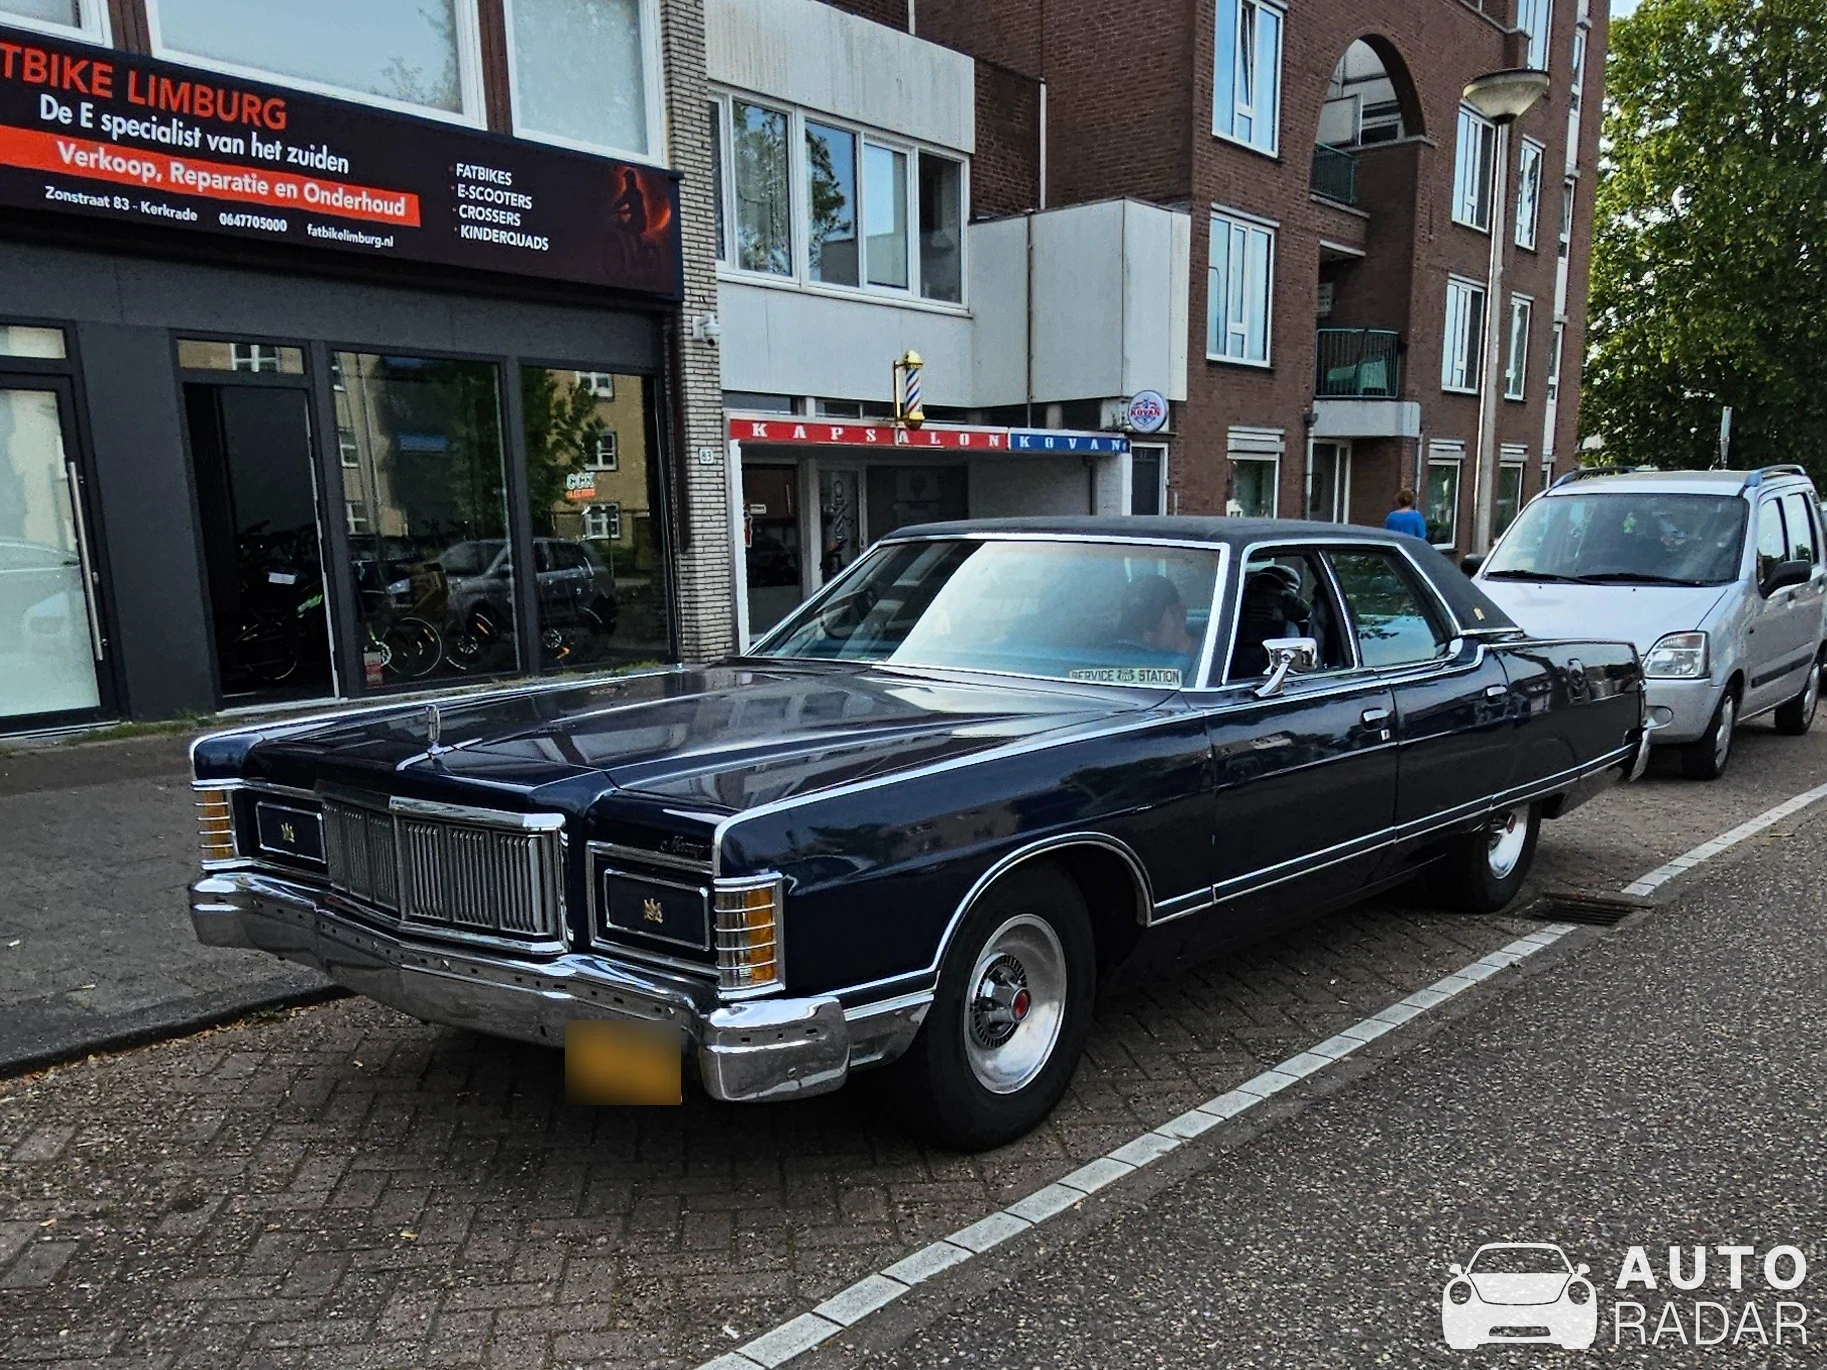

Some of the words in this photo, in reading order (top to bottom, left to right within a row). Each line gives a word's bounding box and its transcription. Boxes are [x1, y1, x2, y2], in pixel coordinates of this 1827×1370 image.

[0, 42, 113, 98] TBIKE
[128, 69, 287, 130] LIMBURG
[40, 93, 73, 123] De
[80, 101, 94, 128] E
[101, 114, 202, 148] specialist
[206, 134, 243, 156] van
[251, 131, 282, 161] het
[287, 143, 349, 174] zuiden
[57, 141, 162, 183] Verkoop,
[170, 161, 268, 196] Reparatie
[275, 180, 298, 199] en
[303, 182, 406, 217] Onderhoud
[456, 162, 512, 186] FATBIKES
[45, 185, 110, 208] Zonstraat
[113, 196, 129, 211] 83
[140, 200, 198, 221] Kerkrade
[457, 183, 533, 210] E-SCOOTERS
[219, 212, 287, 232] 0647705000
[459, 204, 521, 227] CROSSERS
[306, 223, 394, 248] fatbikelimburg.nl
[460, 224, 549, 251] KINDERQUADS
[1130, 407, 1160, 417] KOVAN
[752, 422, 999, 447] KAPSALON
[1019, 436, 1121, 451] KOVAN
[701, 451, 712, 461] 83
[1071, 669, 1114, 681] SERVICE
[1138, 669, 1180, 683] STATION
